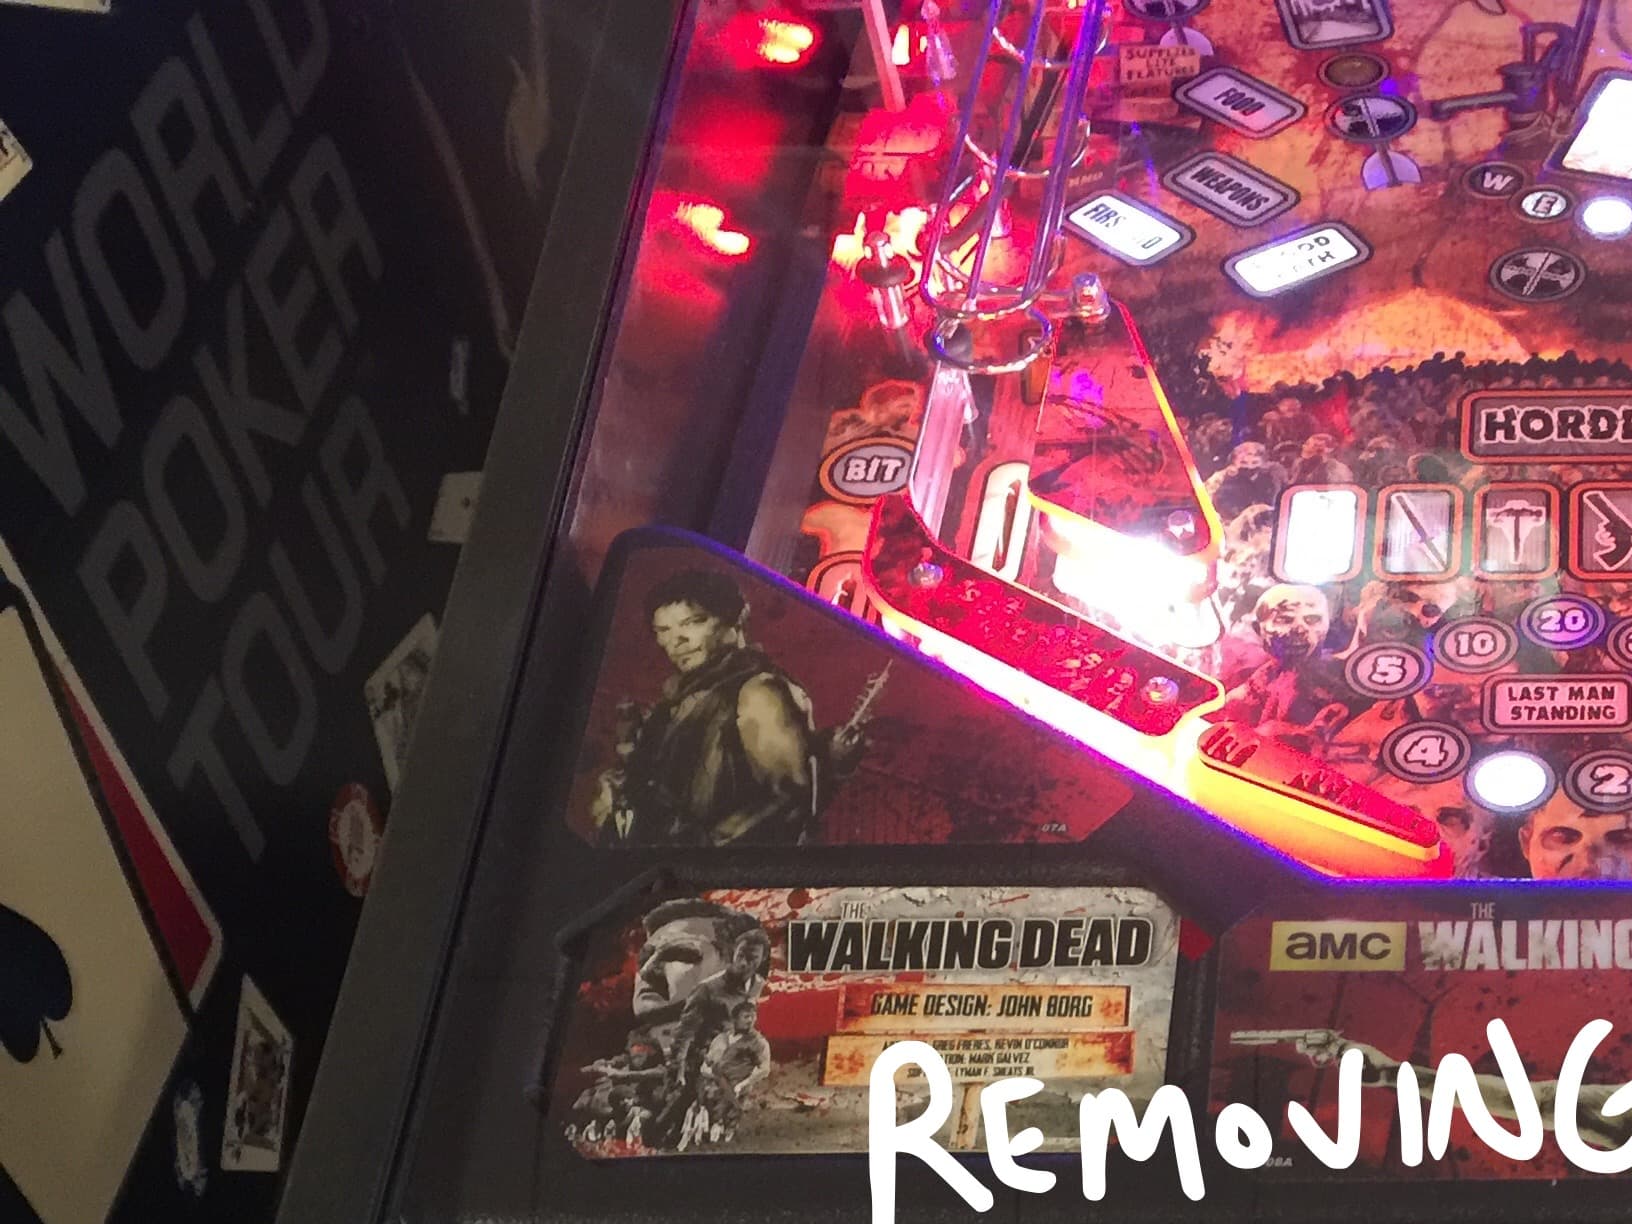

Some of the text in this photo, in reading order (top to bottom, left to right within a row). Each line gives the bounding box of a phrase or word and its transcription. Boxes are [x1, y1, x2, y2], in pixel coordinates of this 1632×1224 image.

[1214, 87, 1265, 116] FOOD
[1190, 166, 1270, 212] WEAPONS
[1483, 172, 1513, 191] W
[76, 134, 384, 724] POKER
[844, 456, 903, 484] BIT
[167, 397, 410, 862] TOUR
[1537, 608, 1587, 634] 20
[1455, 631, 1496, 655] 10
[1368, 657, 1403, 685] 5
[1507, 685, 1616, 701] LAST MAN
[1510, 704, 1617, 721] STANDING
[1404, 734, 1447, 767] 4
[1592, 764, 1631, 794] 2
[841, 902, 866, 918] THE
[1471, 902, 1496, 919] THE
[788, 917, 1155, 972] WALKING DEAD
[870, 993, 1094, 1018] GAME DESIGN: JOHN BORG
[969, 1053, 993, 1065] MARK
